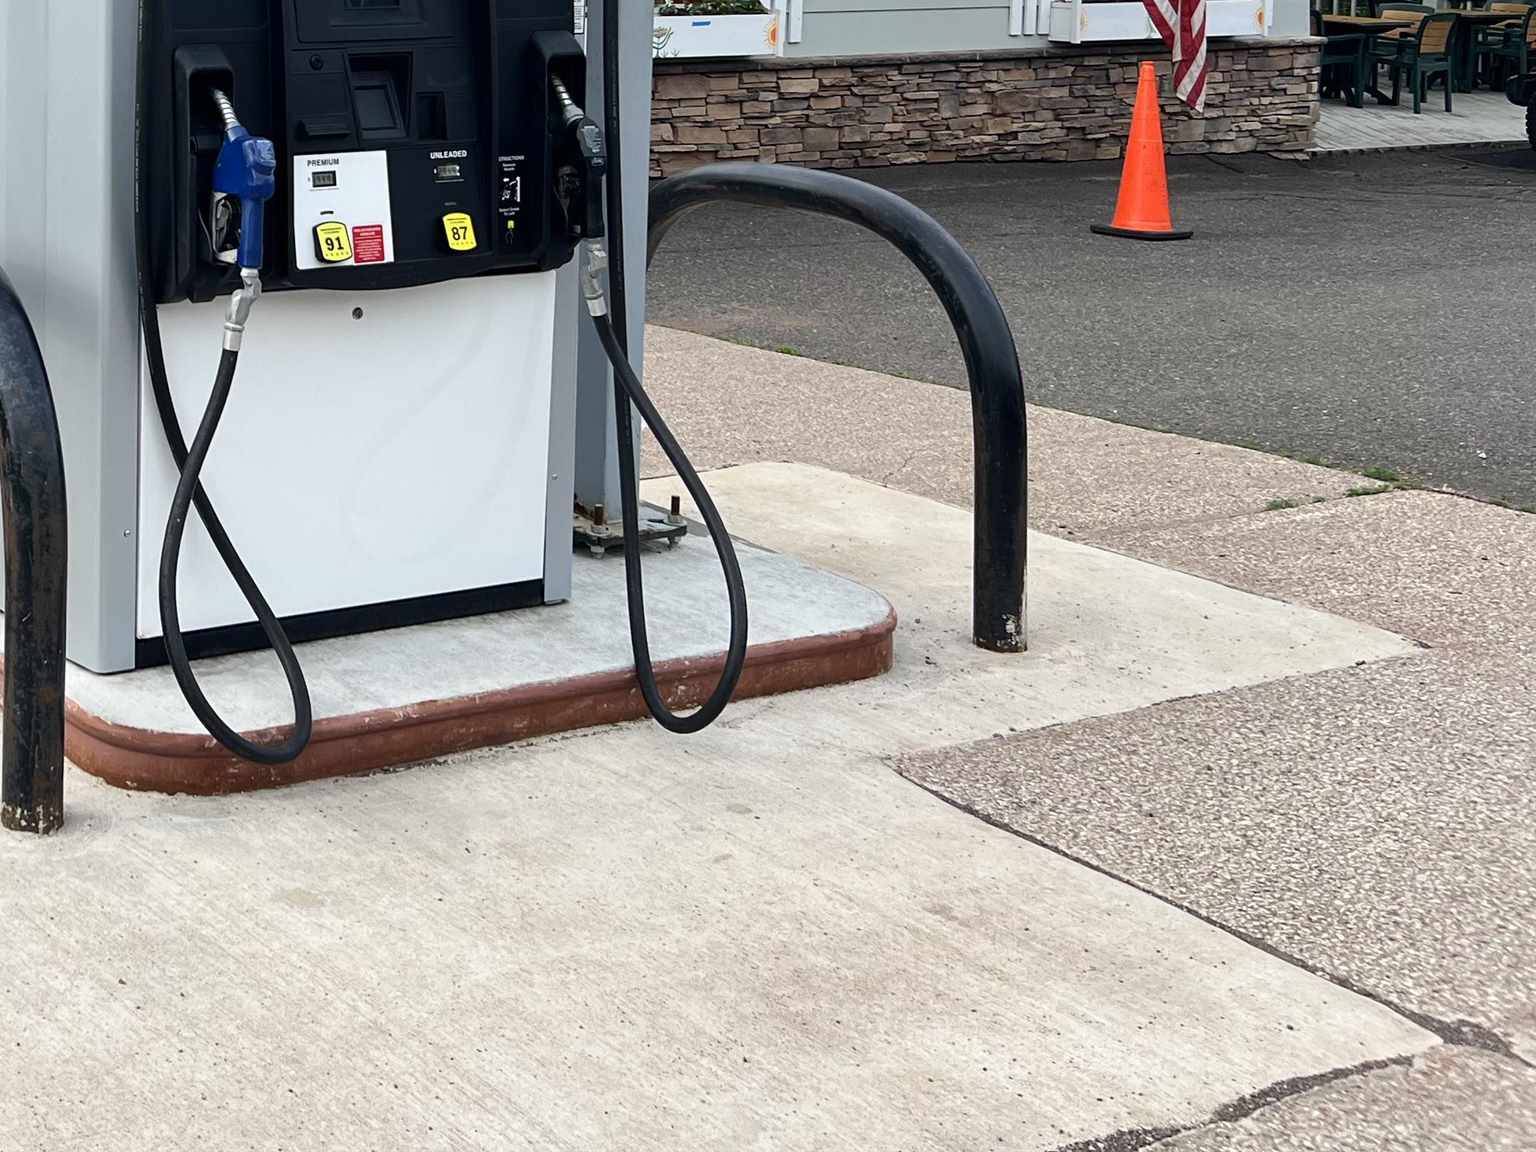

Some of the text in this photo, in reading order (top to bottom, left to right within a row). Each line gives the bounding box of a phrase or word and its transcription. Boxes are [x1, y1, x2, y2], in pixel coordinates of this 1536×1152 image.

[430, 150, 468, 160] UNLEADED
[306, 158, 340, 168] PREMIUM
[451, 226, 468, 241] 87
[325, 235, 345, 252] 91
